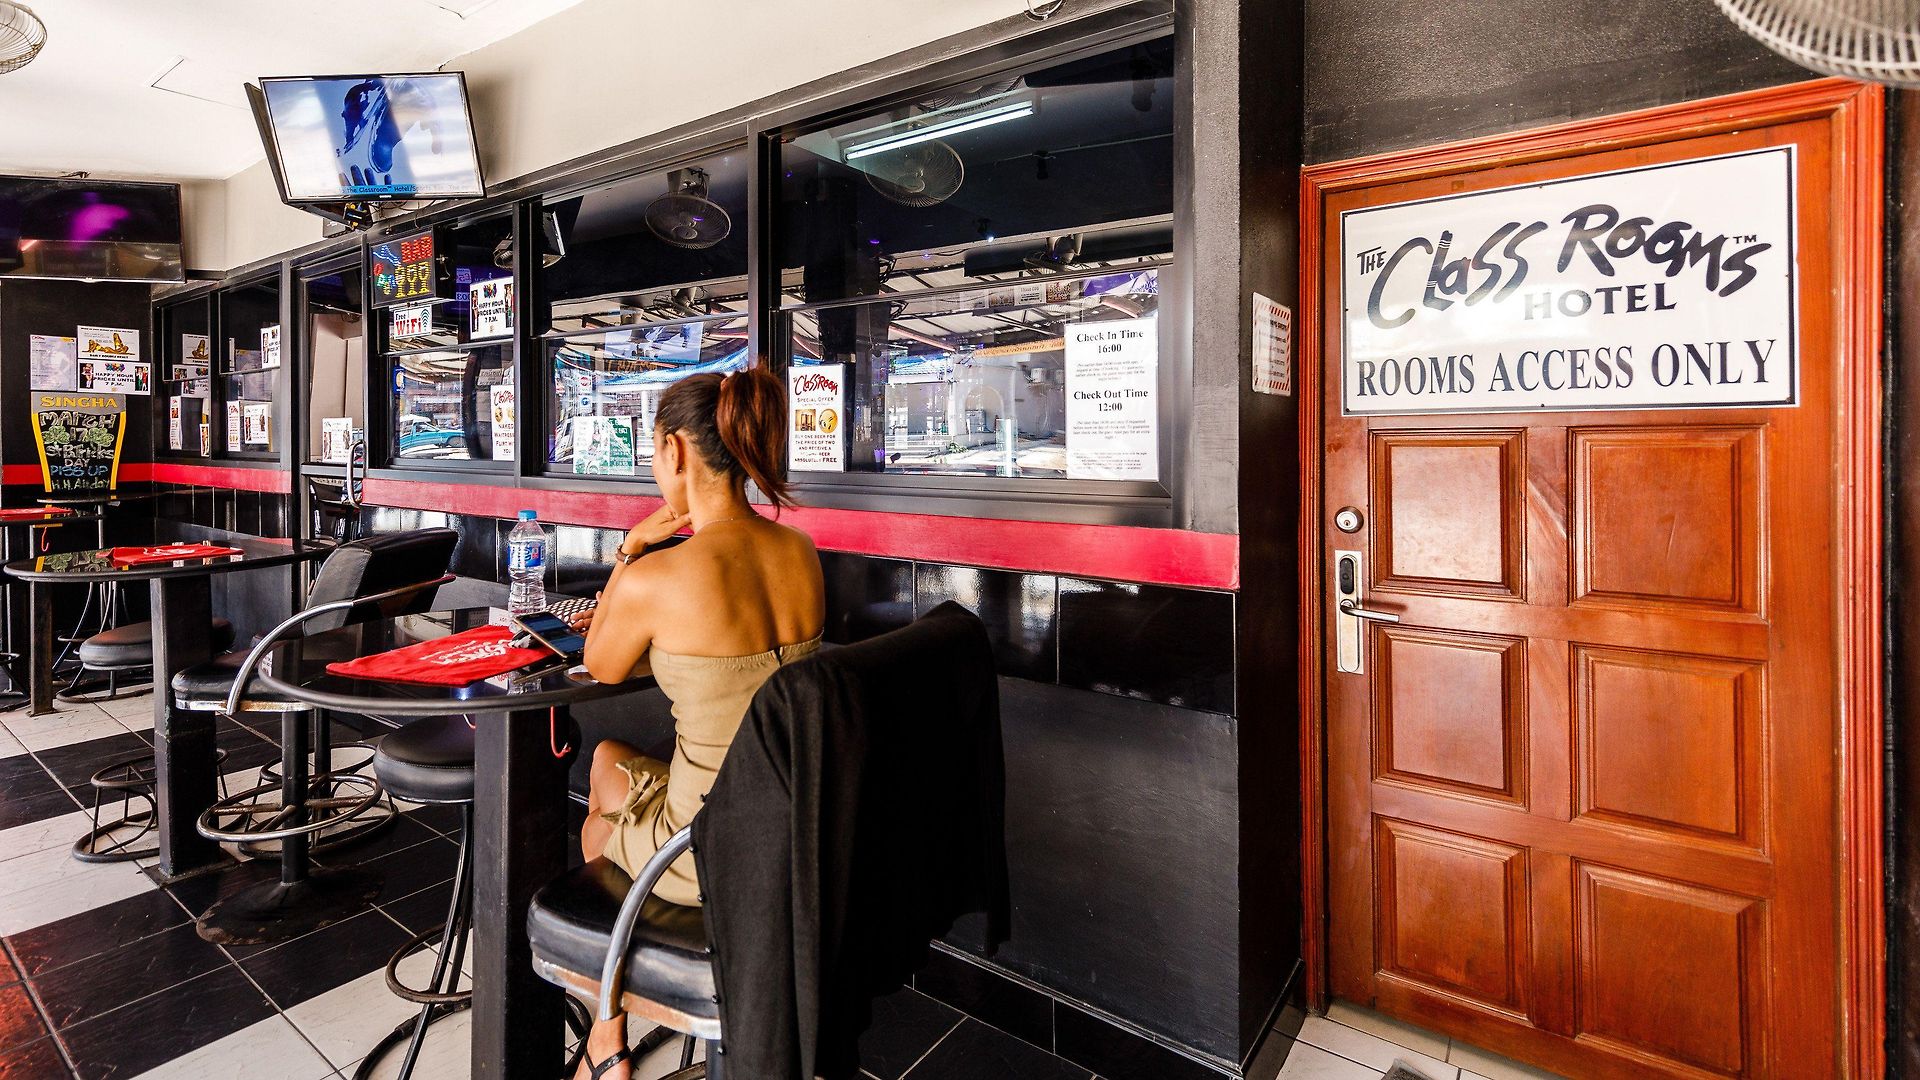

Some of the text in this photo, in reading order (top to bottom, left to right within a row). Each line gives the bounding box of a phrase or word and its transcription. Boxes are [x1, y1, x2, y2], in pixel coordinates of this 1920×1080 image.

[401, 236, 432, 263] BAR
[1523, 282, 1678, 321] HOTEL
[395, 313, 406, 321] Free
[396, 318, 422, 336] WiFi
[1076, 330, 1144, 342] Check In Time
[1098, 344, 1122, 354] 16:00
[1357, 338, 1778, 397] ROOMS ACCESS ONLY
[1074, 389, 1148, 400] Check Out Time
[41, 396, 118, 408] SINGHA
[1099, 402, 1122, 412] 12:00
[70, 427, 88, 442] 17
[65, 459, 90, 468] DAY
[50, 465, 108, 476] PISS UP
